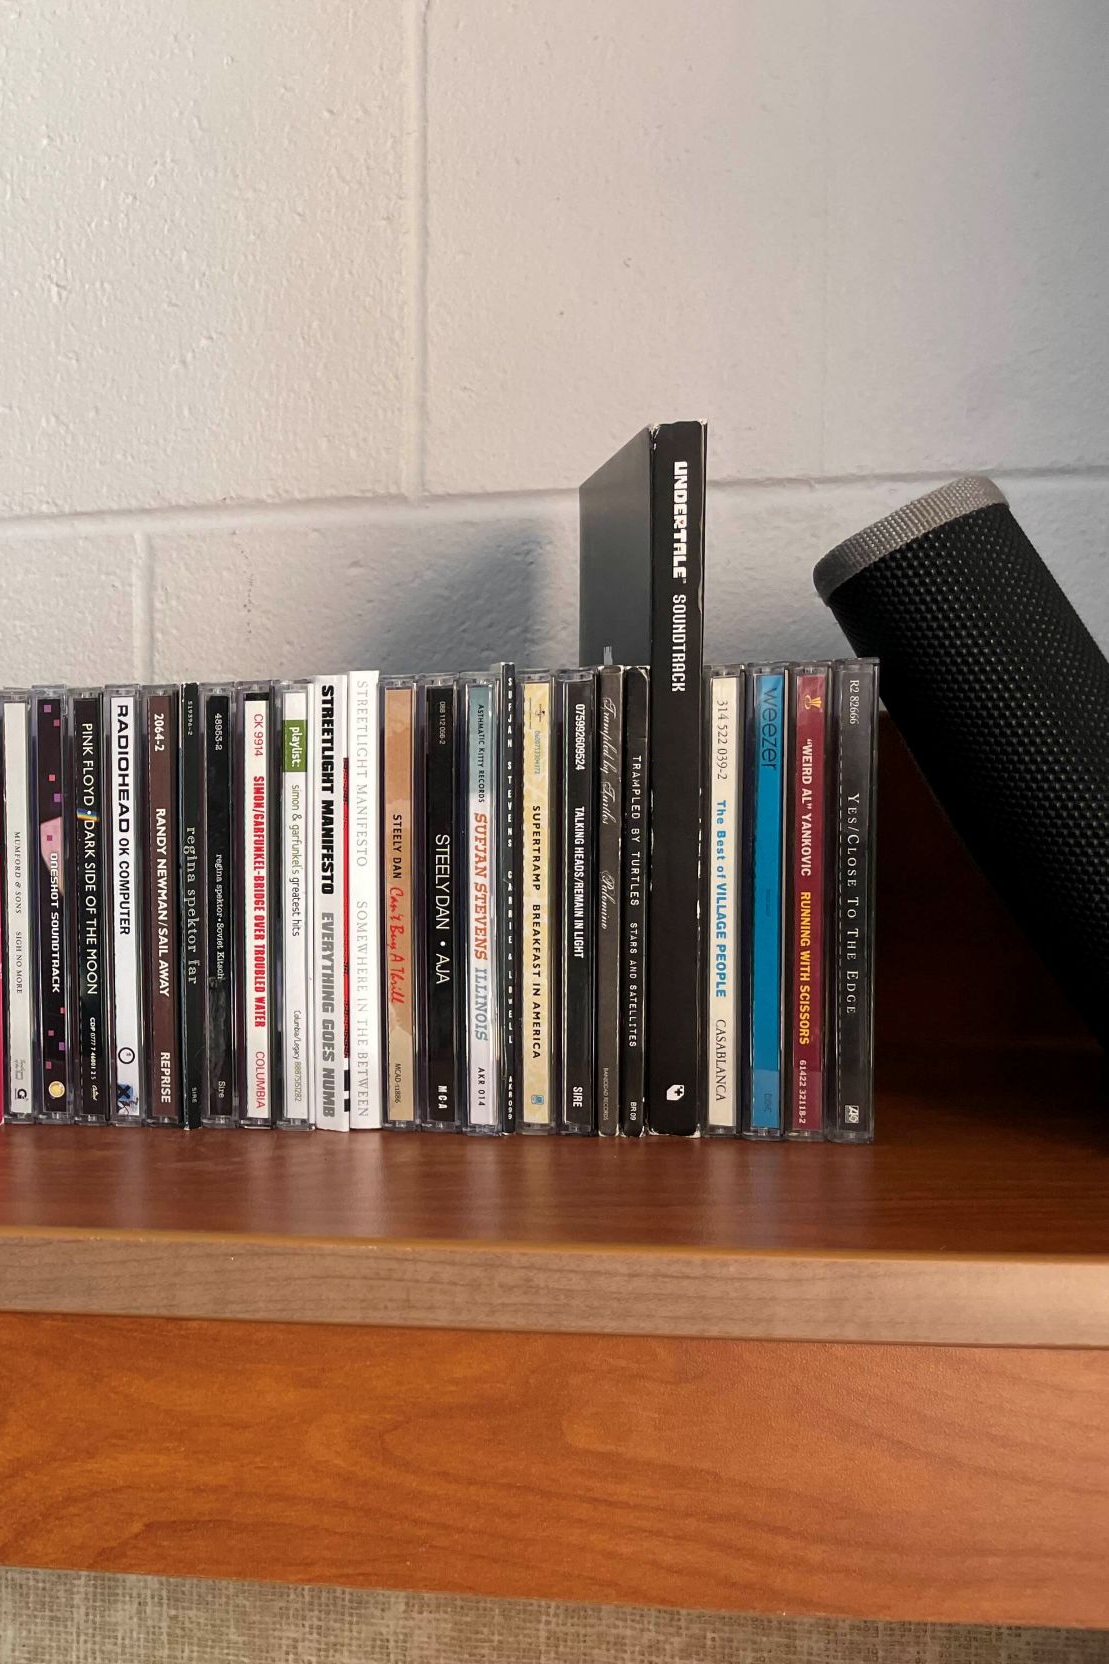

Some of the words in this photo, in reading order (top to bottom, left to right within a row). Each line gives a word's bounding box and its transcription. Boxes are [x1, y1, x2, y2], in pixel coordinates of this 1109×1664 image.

[673, 461, 688, 578] UNDERTALE
[671, 595, 686, 692] SOUNDTRACK
[850, 680, 859, 692] R2
[254, 714, 263, 728] CK
[356, 681, 368, 778] STREETLIGHT
[717, 700, 729, 720] 314
[762, 688, 778, 770] weezer
[850, 696, 859, 724] 82666
[82, 723, 93, 756] PINK
[154, 714, 164, 751] 2064-2
[254, 732, 263, 756] 9914
[290, 727, 301, 767] playlist:
[322, 685, 334, 793] STREETLIGHT
[575, 704, 585, 770] 075992609524
[717, 725, 728, 744] 522
[83, 761, 94, 806] FLOYD
[117, 705, 129, 832] RADIOHEAD
[717, 749, 727, 780] 039-2
[631, 756, 641, 819] TRAMPLED
[357, 784, 367, 867] MANIFESTO
[393, 815, 401, 853] STEELY
[717, 800, 726, 824] The
[84, 820, 95, 857] DARK
[119, 838, 129, 856] OK
[184, 827, 197, 882] regina
[322, 800, 334, 894] MANIFESTO
[474, 813, 487, 878] SUFJAN
[631, 828, 640, 842] BY
[717, 831, 726, 860] Best
[50, 853, 59, 908] ONESHOT
[85, 863, 96, 891] SIDE
[393, 858, 401, 878] DAN
[436, 835, 449, 891] STEELY
[630, 852, 640, 906] TURTLES
[717, 867, 726, 878] of
[86, 896, 96, 914] OF
[119, 861, 130, 935] COMPUTER
[436, 896, 449, 929] DAN
[716, 883, 727, 938] VILLAGE
[87, 919, 97, 944] THE
[184, 890, 199, 952] spektor
[475, 883, 487, 960] STEVENS
[532, 905, 541, 977] BREAKFAST
[629, 923, 637, 954] STARS
[51, 913, 60, 992] SOUNDTRACK
[322, 913, 334, 1013] EVERYTHING
[357, 901, 368, 991] SOMEWHERE
[87, 950, 97, 994] MOON
[188, 960, 200, 984] far
[436, 954, 449, 984] AJA
[533, 983, 541, 996] IN
[629, 960, 637, 978] AND
[716, 945, 726, 997] PEOPLE
[357, 998, 368, 1011] IN
[475, 968, 488, 1041] ILLINOIS
[629, 985, 637, 1047] SATELLITES
[323, 1019, 334, 1061] GOES
[358, 1019, 368, 1045] THE
[533, 1002, 541, 1059] AMERICA
[161, 1052, 171, 1103] REPRISE
[256, 1052, 265, 1108] COLUMBIA
[716, 1020, 726, 1101] CASABLANCA
[218, 1081, 226, 1098] Sire
[323, 1068, 335, 1117] NUMB
[358, 1053, 368, 1116] BETWEEN
[573, 1087, 582, 1107] SIRE
